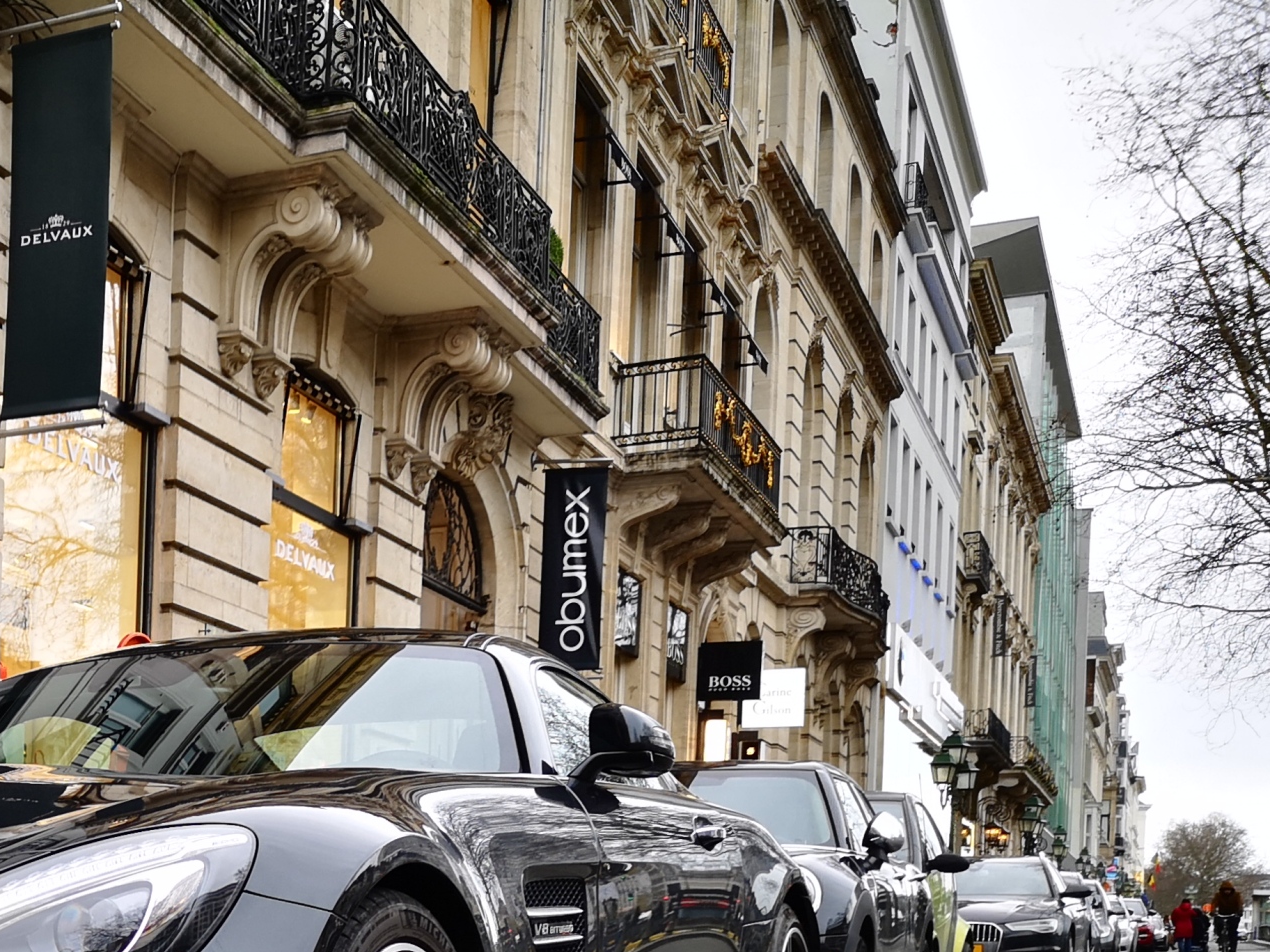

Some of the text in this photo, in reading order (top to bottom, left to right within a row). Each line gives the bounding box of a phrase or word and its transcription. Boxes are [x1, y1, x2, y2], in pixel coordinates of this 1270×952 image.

[20, 224, 93, 247] DELVAUX
[27, 421, 119, 482] DELVAUX
[275, 538, 335, 581] DELVAUX
[555, 486, 591, 652] obumex
[708, 675, 752, 688] BOSS
[534, 923, 549, 935] V8
